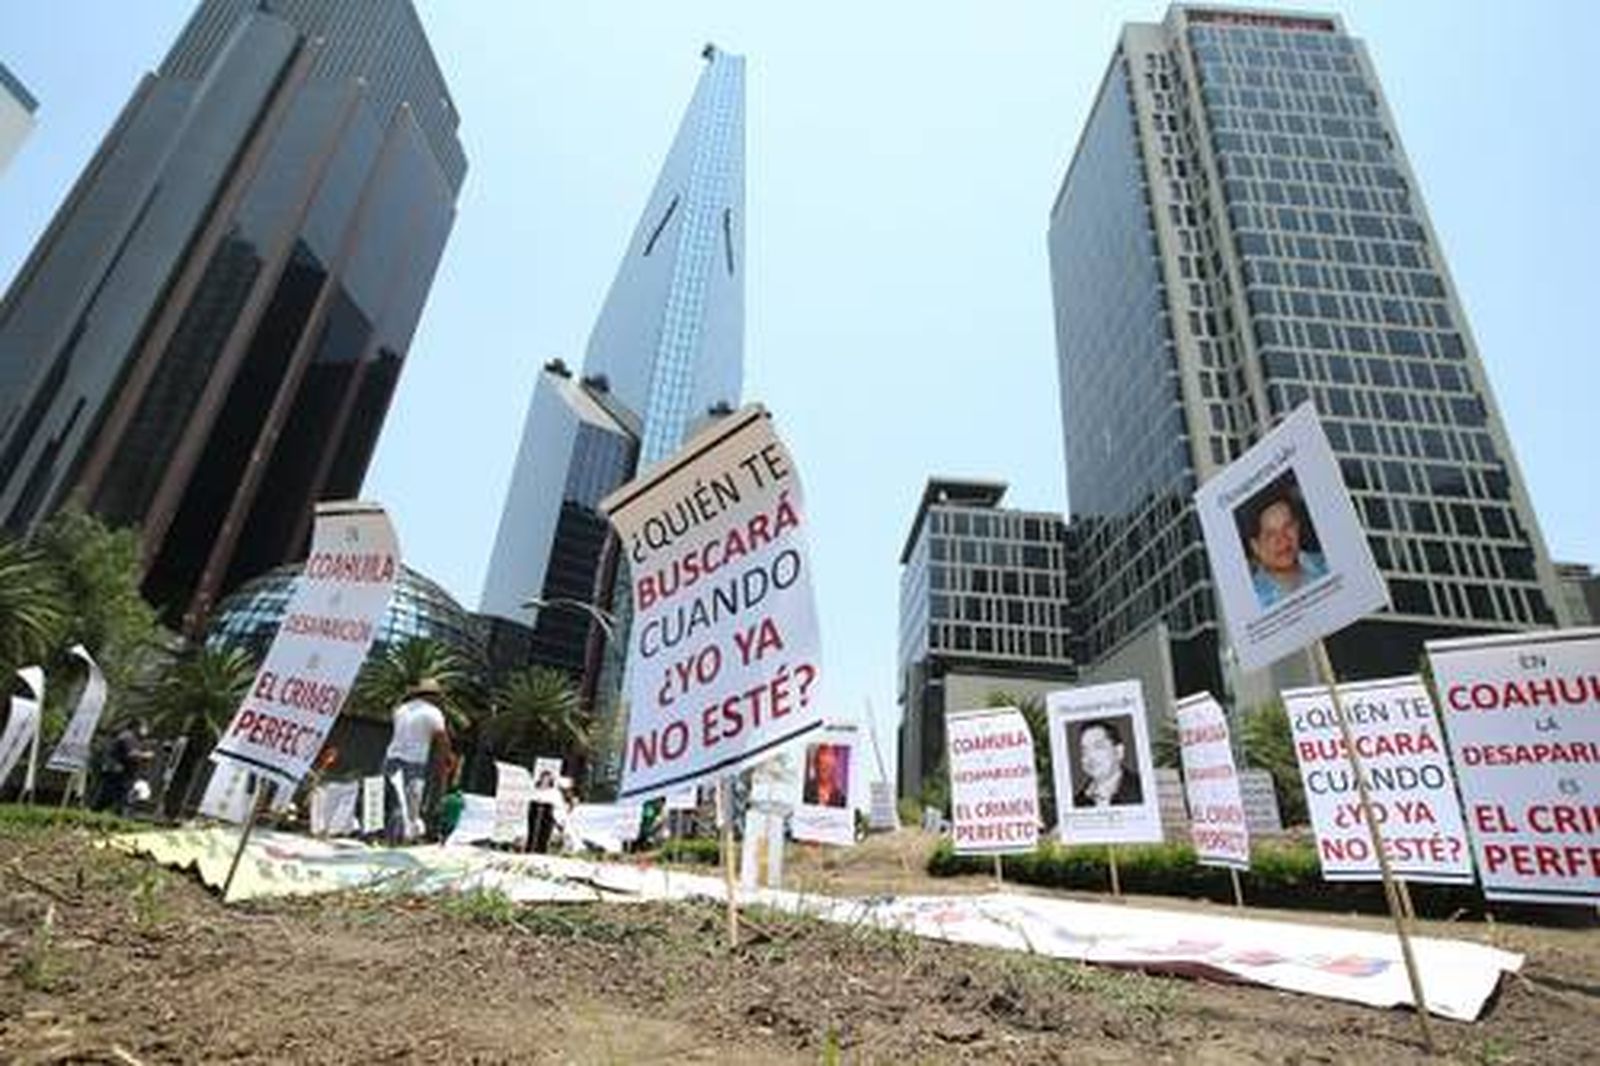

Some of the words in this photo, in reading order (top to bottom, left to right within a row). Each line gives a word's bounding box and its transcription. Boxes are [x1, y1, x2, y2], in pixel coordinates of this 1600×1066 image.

[632, 477, 740, 563] ¿QUIÉN
[741, 445, 788, 489] TE
[636, 492, 799, 611] BUSCARÁ
[639, 549, 801, 659] CUANDO
[657, 645, 722, 706] ¿YO
[733, 617, 784, 667] YA
[255, 671, 278, 701] EL
[630, 720, 690, 772] NO
[702, 664, 816, 749] ESTÉ?
[1295, 697, 1389, 732] ¿QUIÉN
[1397, 697, 1430, 720] TE
[1299, 725, 1438, 762] BUSCARÁ
[1307, 763, 1445, 794] CUANDO
[1335, 803, 1388, 828] ¿YO
[1395, 801, 1437, 824] YA
[1475, 804, 1518, 833] EL
[1321, 837, 1369, 862] NO
[1382, 832, 1461, 862] ESTÉ?
